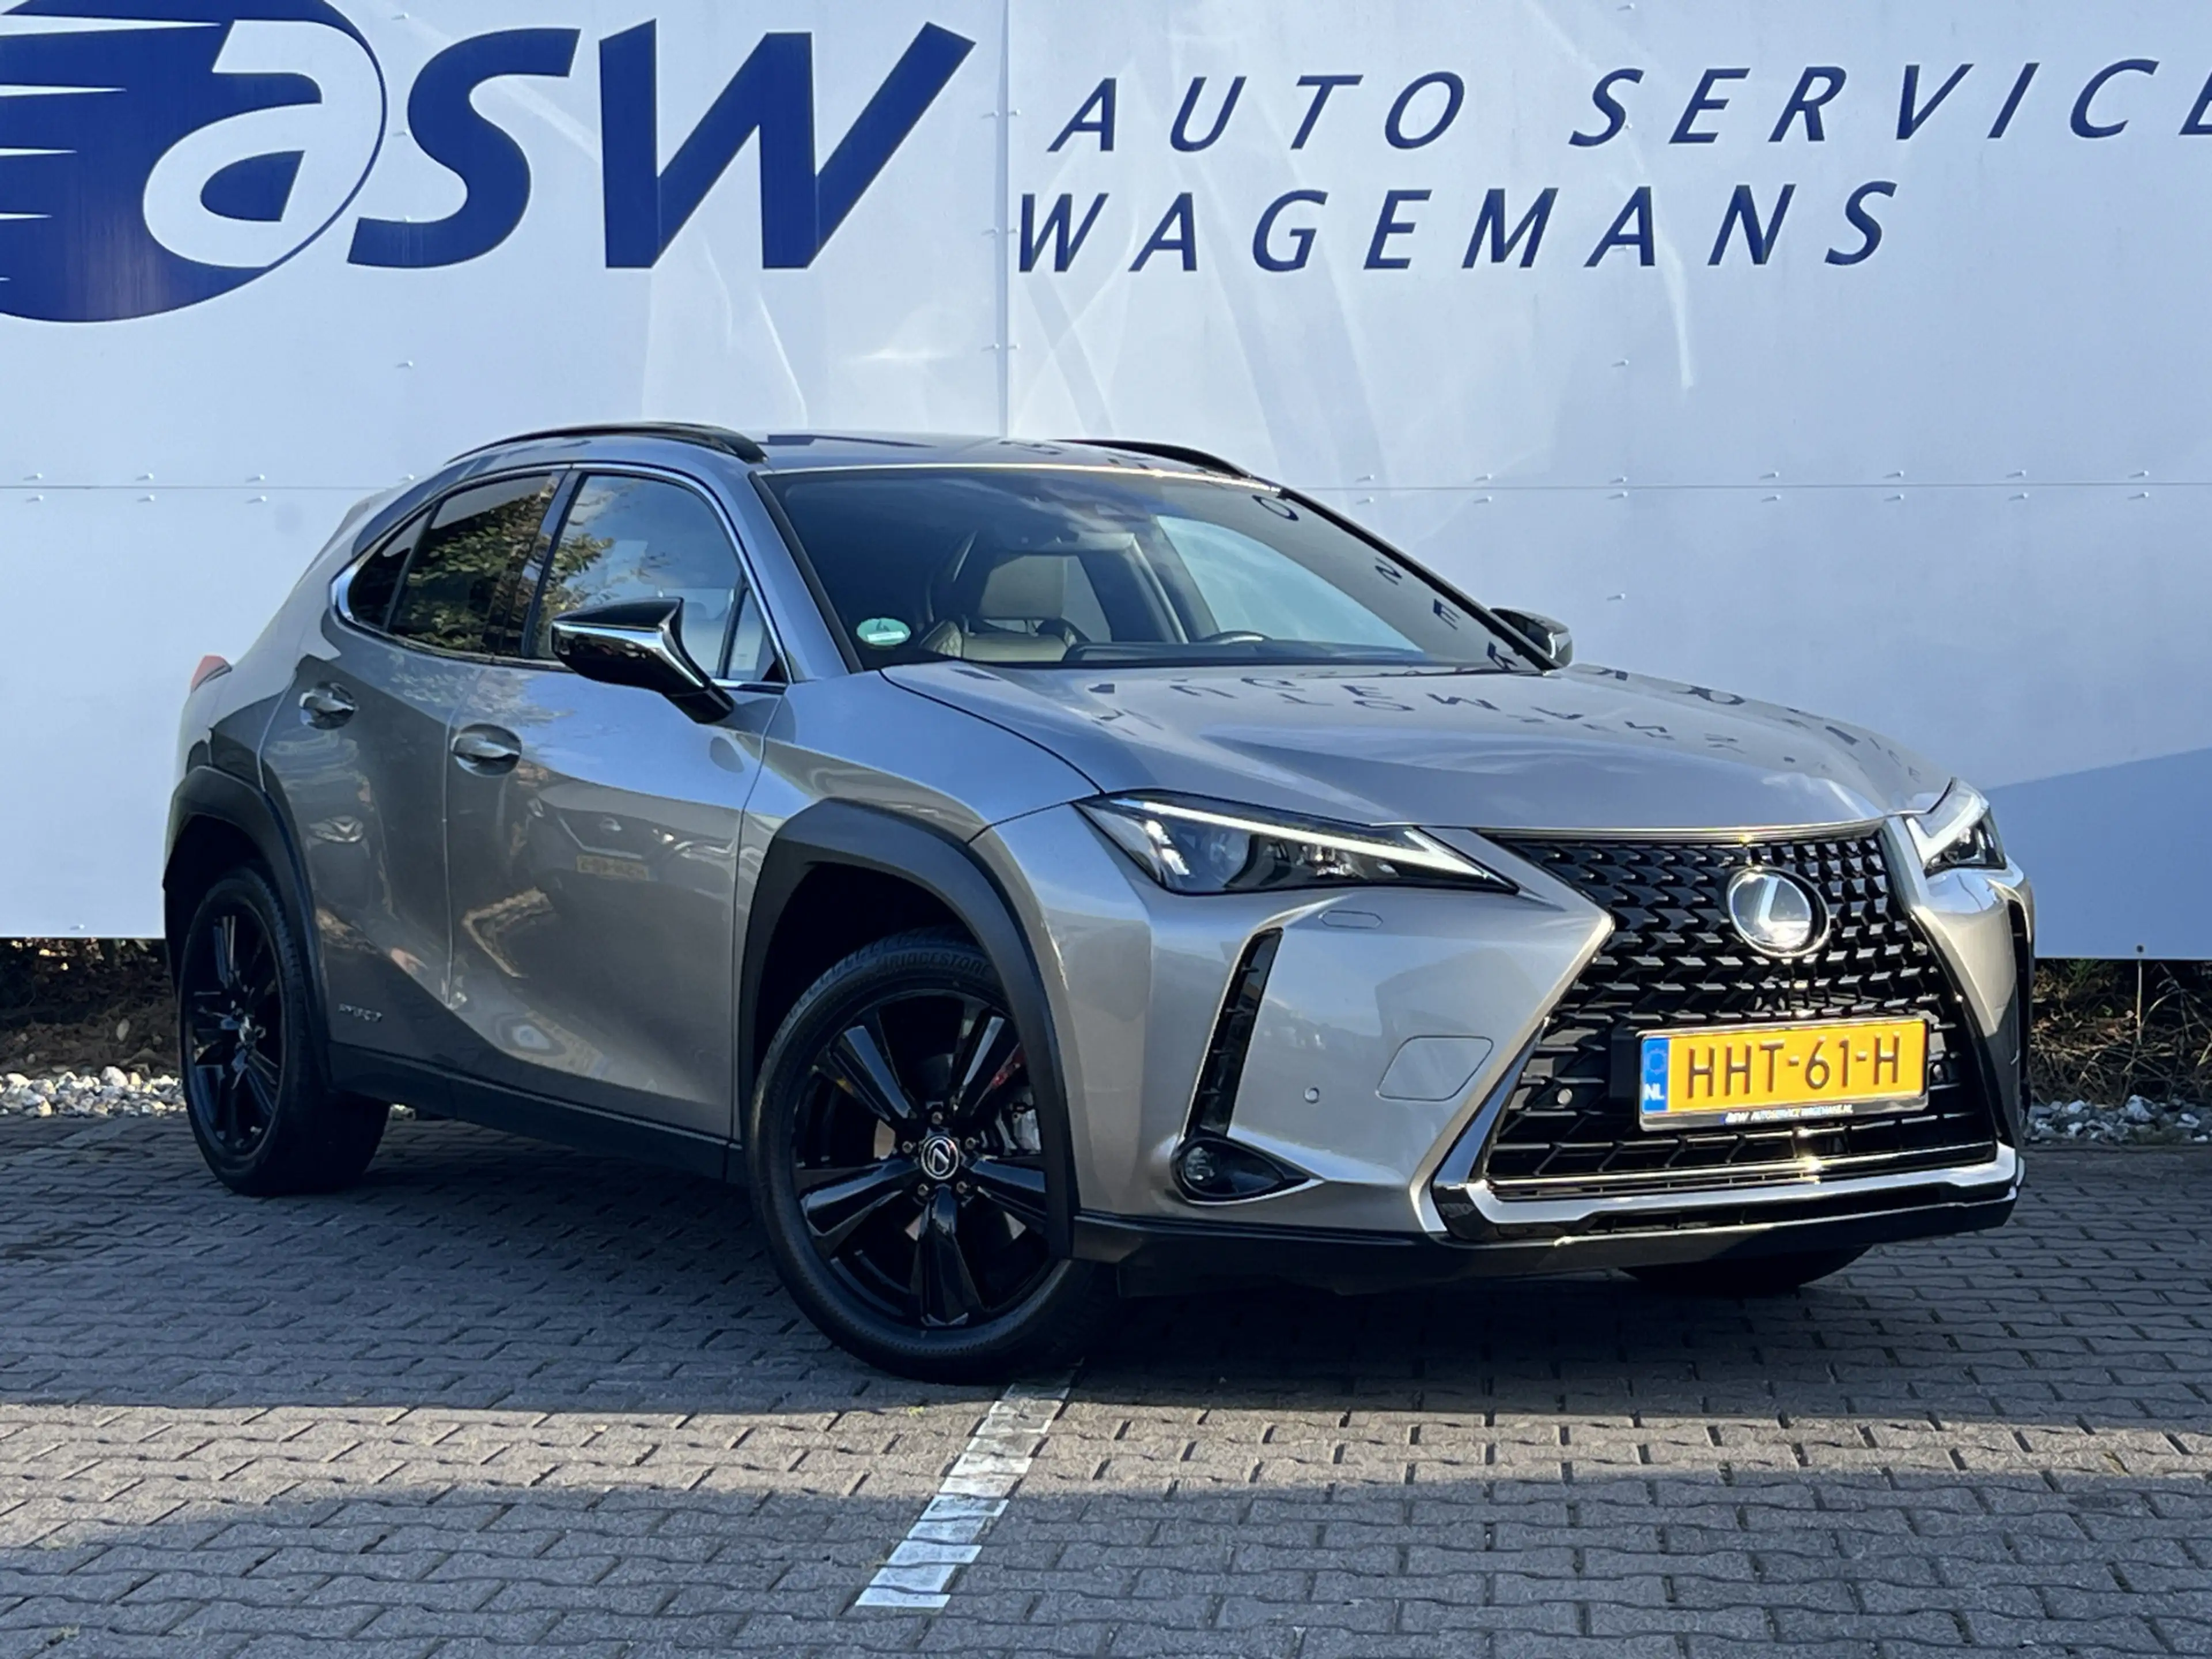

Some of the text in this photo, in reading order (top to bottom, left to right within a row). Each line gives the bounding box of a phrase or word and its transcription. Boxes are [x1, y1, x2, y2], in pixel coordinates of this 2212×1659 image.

[1048, 73, 1464, 151] AUTO
[1020, 181, 1896, 272] WAGEMANS
[1643, 1083, 1664, 1100] NL
[1687, 1032, 1900, 1099] HHT-61-H
